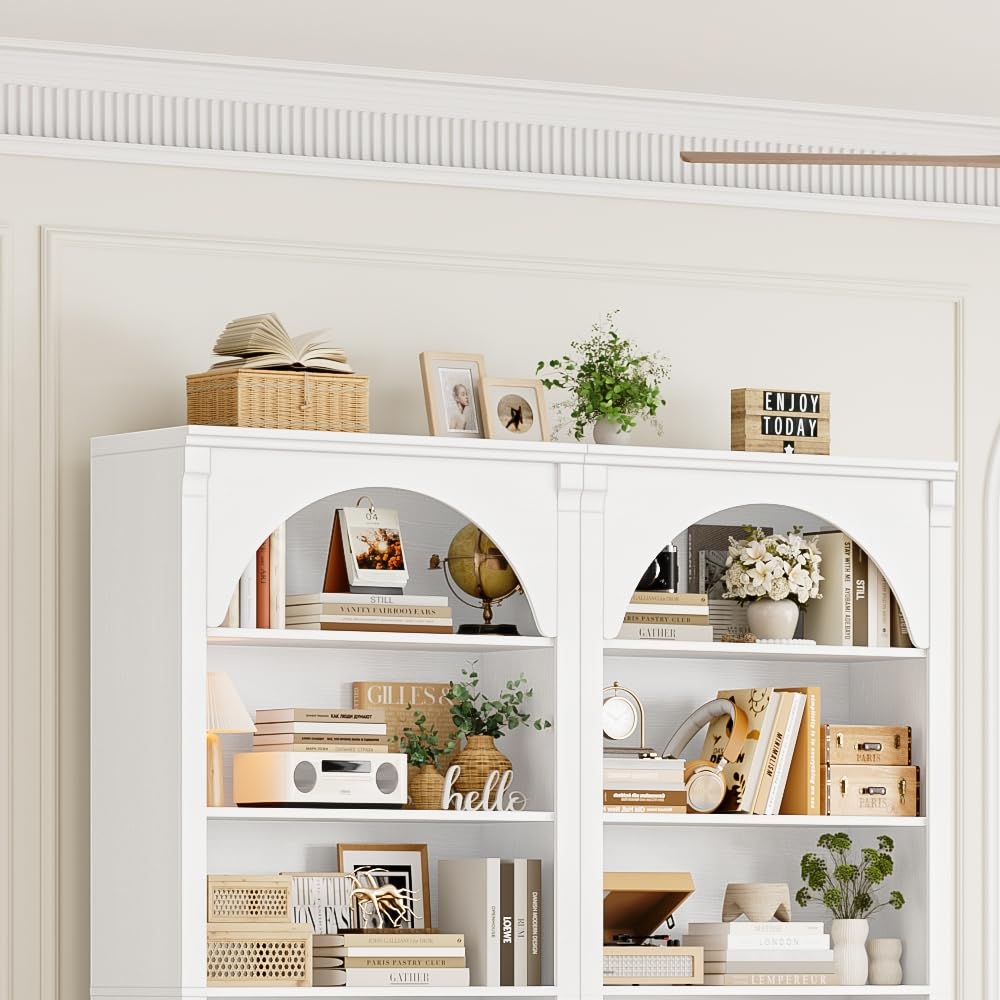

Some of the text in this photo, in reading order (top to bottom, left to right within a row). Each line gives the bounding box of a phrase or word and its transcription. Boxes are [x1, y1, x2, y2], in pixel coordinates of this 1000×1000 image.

[765, 392, 819, 412] ENJOY
[763, 418, 817, 437] TODAY
[366, 512, 378, 521] 04
[856, 579, 864, 600] STILL
[367, 685, 435, 706] GILLES
[768, 732, 782, 778] MINIMALISM
[441, 766, 526, 812] hello
[859, 798, 887, 808] PARIS
[502, 916, 511, 944] LOEWE
